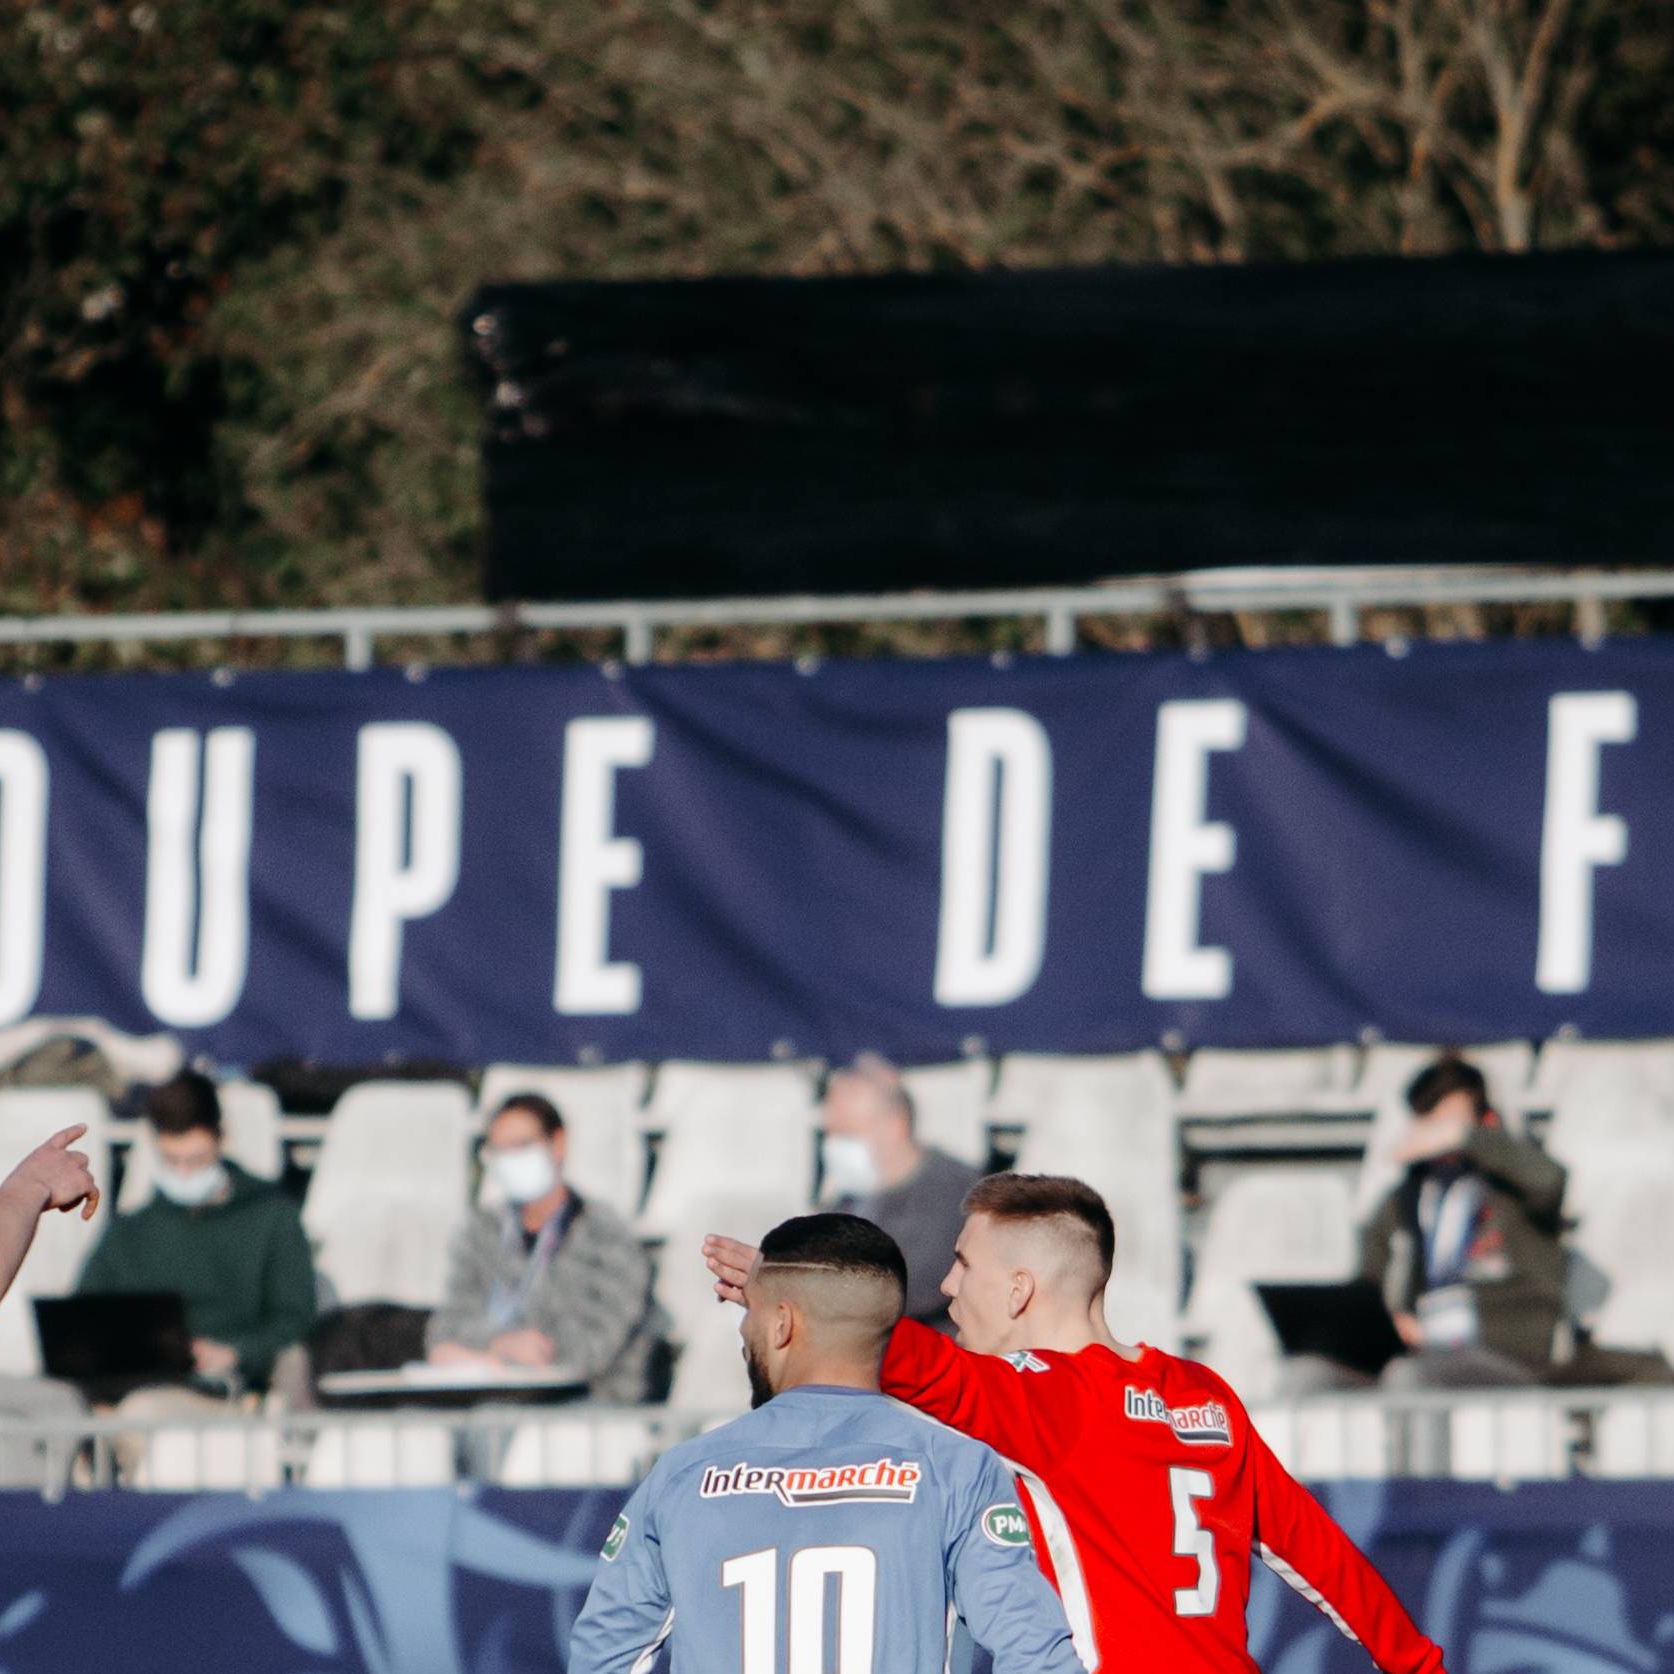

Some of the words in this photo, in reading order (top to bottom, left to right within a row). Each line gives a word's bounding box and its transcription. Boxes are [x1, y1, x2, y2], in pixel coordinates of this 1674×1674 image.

[934, 698, 1247, 1007] DE
[992, 1514, 1027, 1535] PM
[1169, 1466, 1220, 1617] 5
